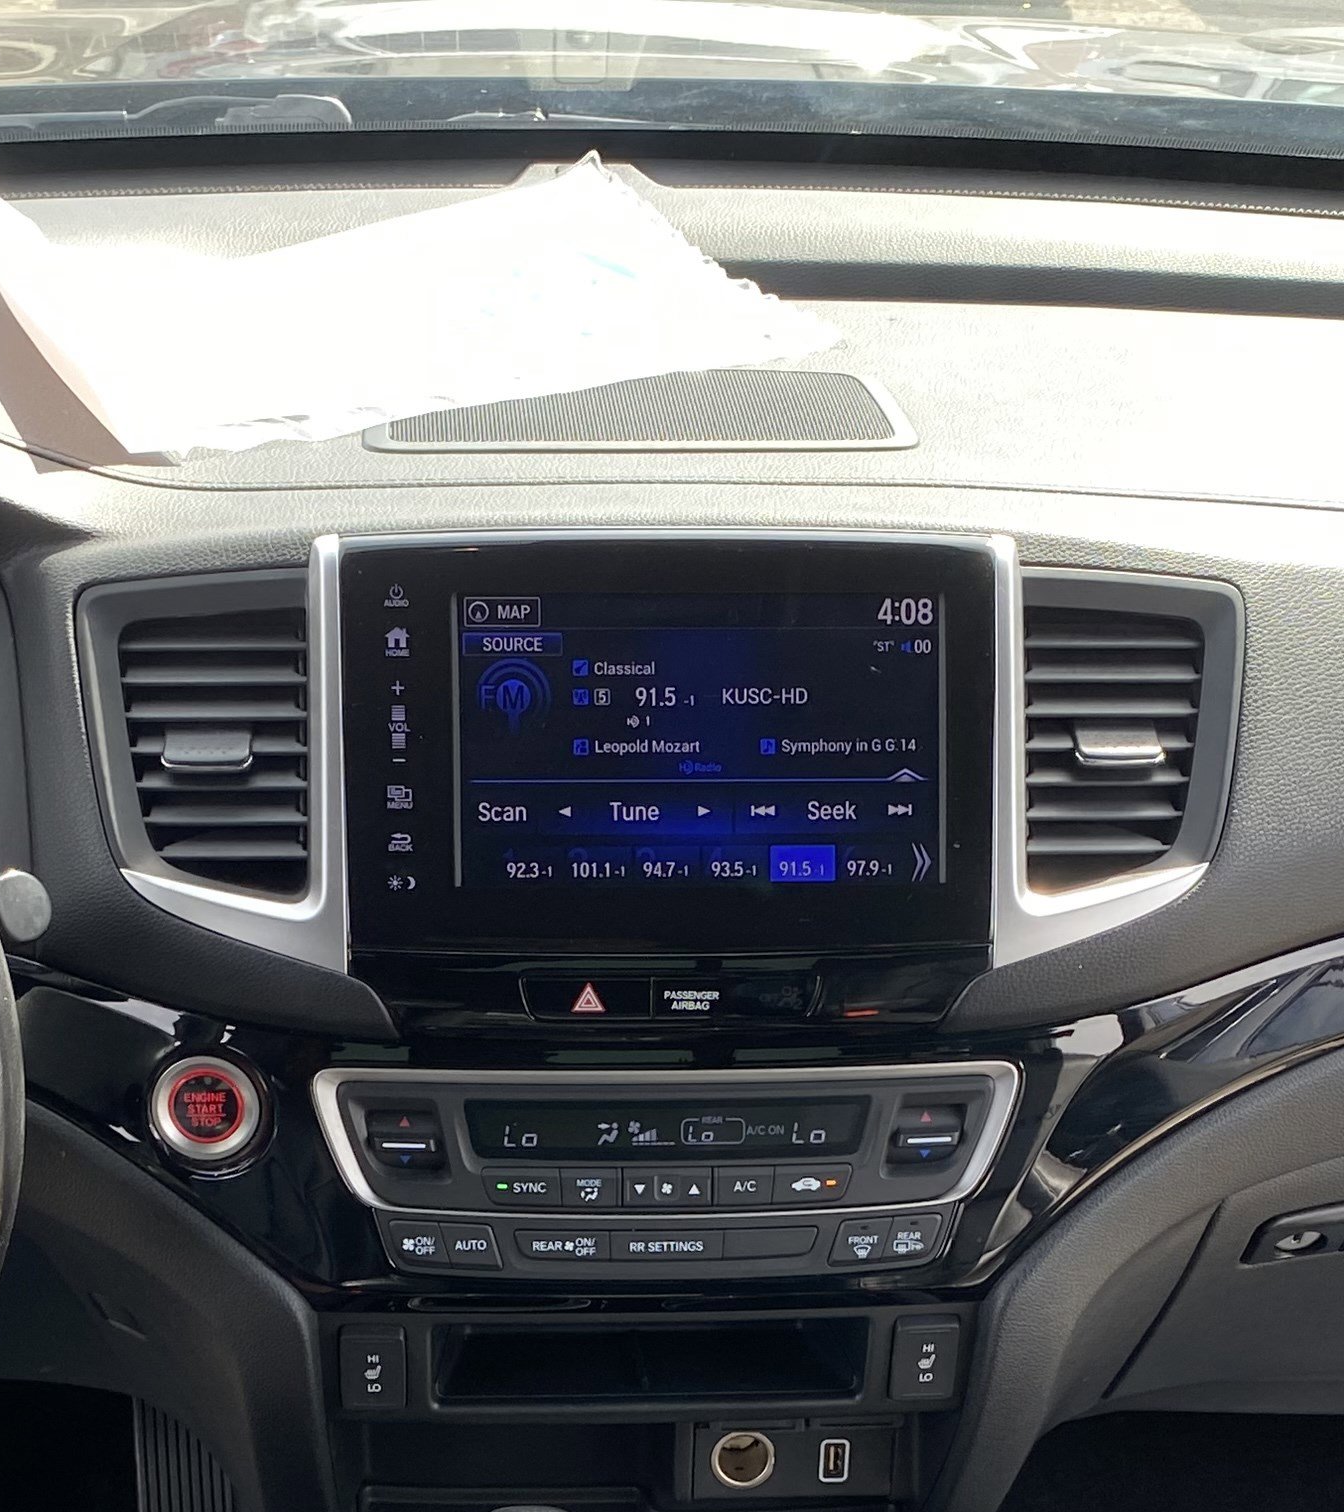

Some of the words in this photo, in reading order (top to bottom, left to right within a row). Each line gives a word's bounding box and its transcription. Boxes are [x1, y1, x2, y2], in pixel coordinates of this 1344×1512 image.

[497, 605, 531, 619] MAP
[877, 598, 933, 625] 4:08
[483, 637, 543, 652] SOURCE
[914, 640, 932, 653] 00
[385, 649, 410, 657] HOME
[594, 661, 655, 675] Classical
[597, 690, 607, 703] 5
[635, 687, 676, 706] 91.5
[722, 688, 808, 704] KUSC-HD
[388, 723, 411, 732] VOL
[595, 740, 648, 756] Leopold
[652, 740, 700, 753] Mozart
[781, 739, 852, 756] Symphony
[856, 738, 868, 751] in
[871, 739, 881, 751] G
[478, 802, 527, 821] Scan
[609, 802, 660, 821] Tune
[807, 800, 857, 820] Seek
[388, 844, 413, 852] BACK
[664, 990, 719, 1000] PASSENGER
[671, 1001, 710, 1010] AIRBAG
[184, 1092, 226, 1102] ENGINE
[187, 1104, 223, 1113] START
[191, 1117, 221, 1127] STOP
[701, 1116, 723, 1124] REAR
[746, 1124, 765, 1136] A/C
[768, 1125, 785, 1135] ON
[513, 1182, 547, 1194] SYNC
[576, 1179, 602, 1188] MODE
[733, 1180, 756, 1192] A/C
[415, 1236, 435, 1246] ON/
[848, 1235, 878, 1244] FRONT
[897, 1232, 921, 1240] REAR
[455, 1240, 486, 1251] AUTO
[532, 1241, 562, 1251] REAR
[575, 1237, 595, 1247] ON/
[629, 1242, 645, 1252] RR
[647, 1241, 703, 1253] SETTINGS
[415, 1246, 435, 1255] OFF
[575, 1247, 596, 1257] OFF
[922, 1343, 935, 1352] HI
[367, 1354, 379, 1363] HI
[919, 1373, 933, 1382] LO
[367, 1383, 381, 1392] LO
